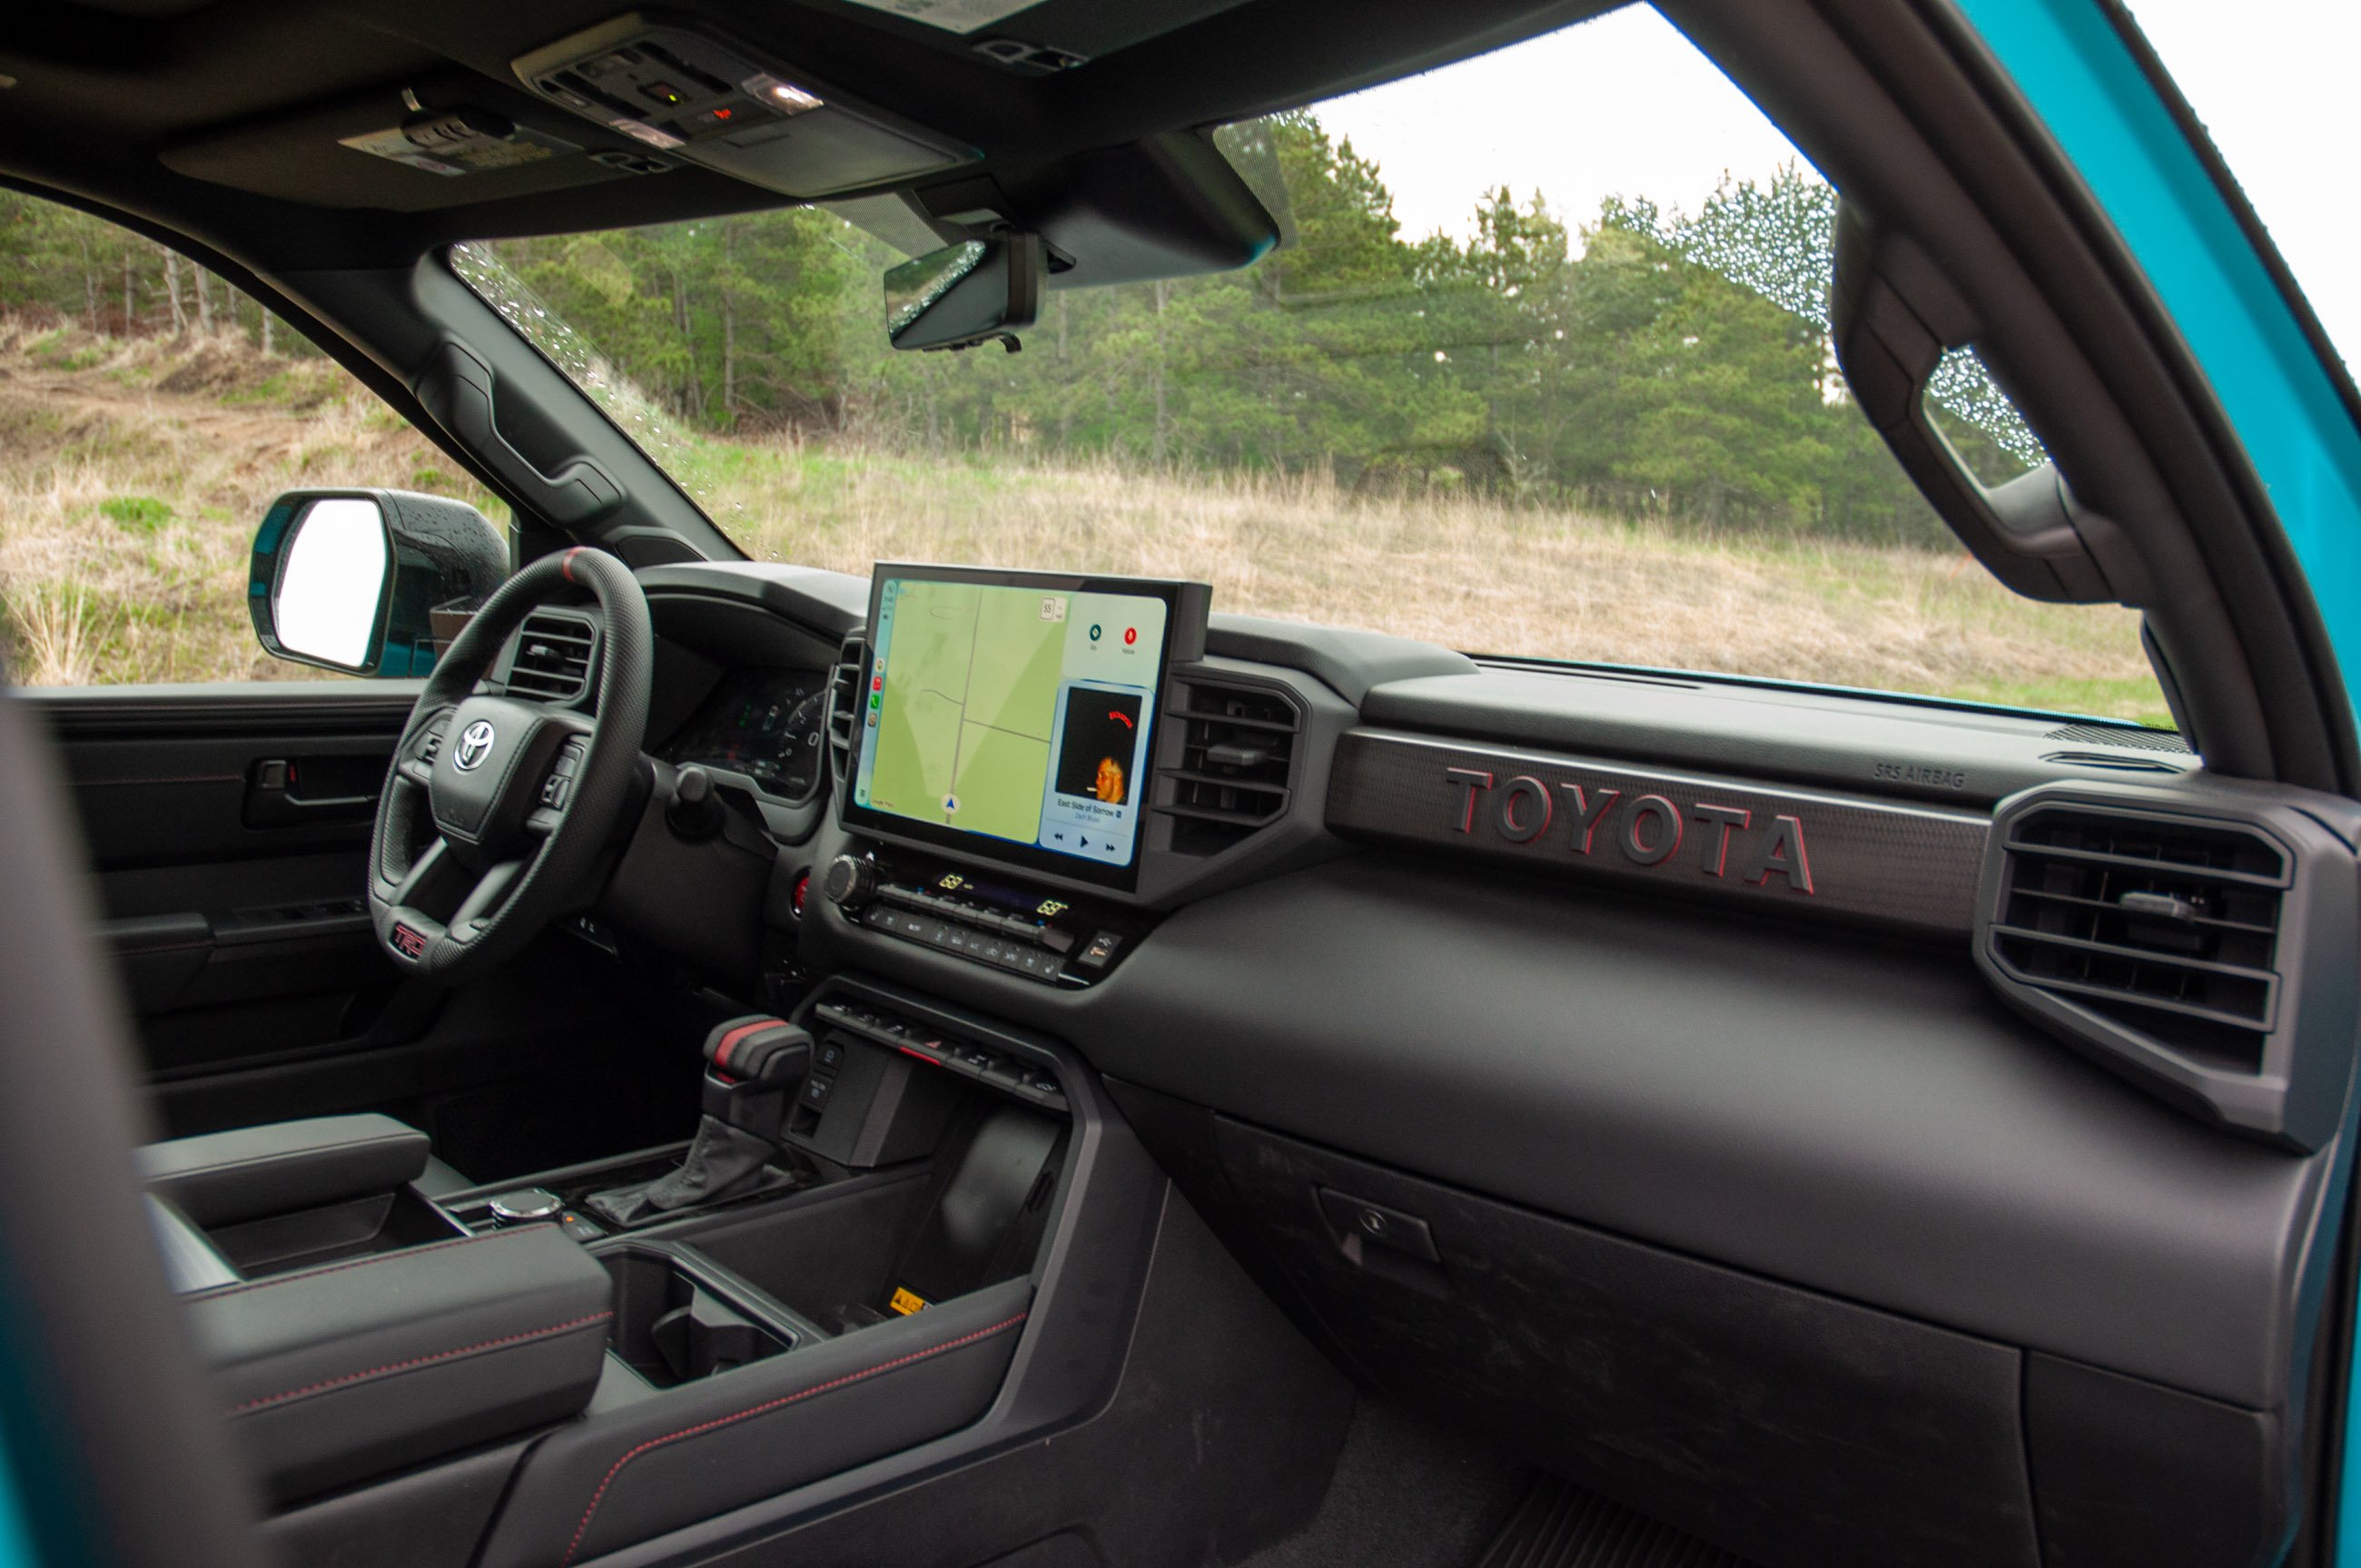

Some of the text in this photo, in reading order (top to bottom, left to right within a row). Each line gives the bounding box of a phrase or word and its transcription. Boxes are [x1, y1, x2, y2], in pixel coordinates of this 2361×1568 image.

[1873, 763, 1965, 789] SRS AIRBAG
[1057, 798, 1072, 809] East
[1072, 801, 1084, 812] Side
[1092, 805, 1114, 817] Sorrow
[1446, 766, 1814, 896] TOYOTA
[394, 924, 426, 957] TRD
